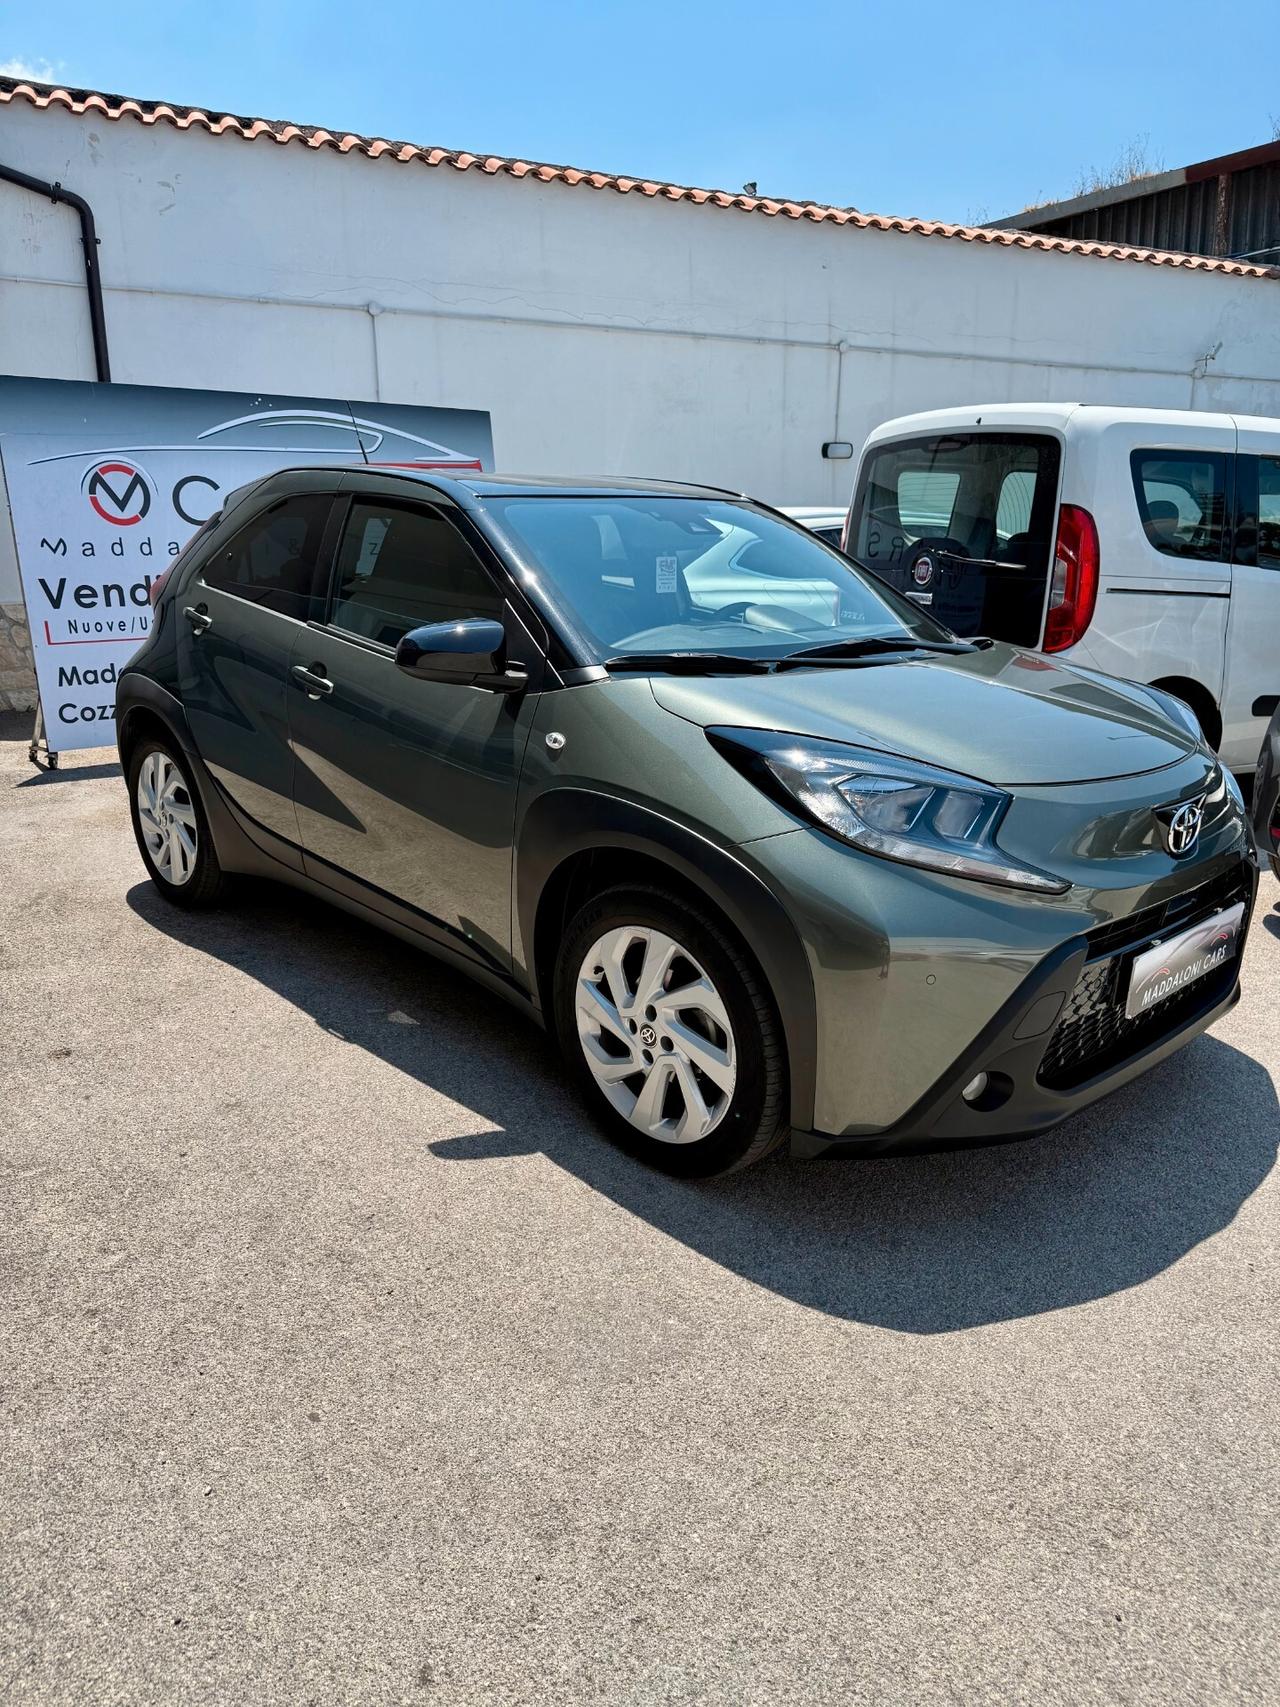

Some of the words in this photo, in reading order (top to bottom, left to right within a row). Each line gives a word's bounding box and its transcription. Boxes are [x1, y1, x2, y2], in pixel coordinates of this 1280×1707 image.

[38, 574, 162, 610] Vend
[67, 616, 154, 634] Nuove/U
[58, 662, 122, 687] Mad
[1141, 960, 1203, 1006] MADDALONI
[1203, 944, 1227, 970] CARS
